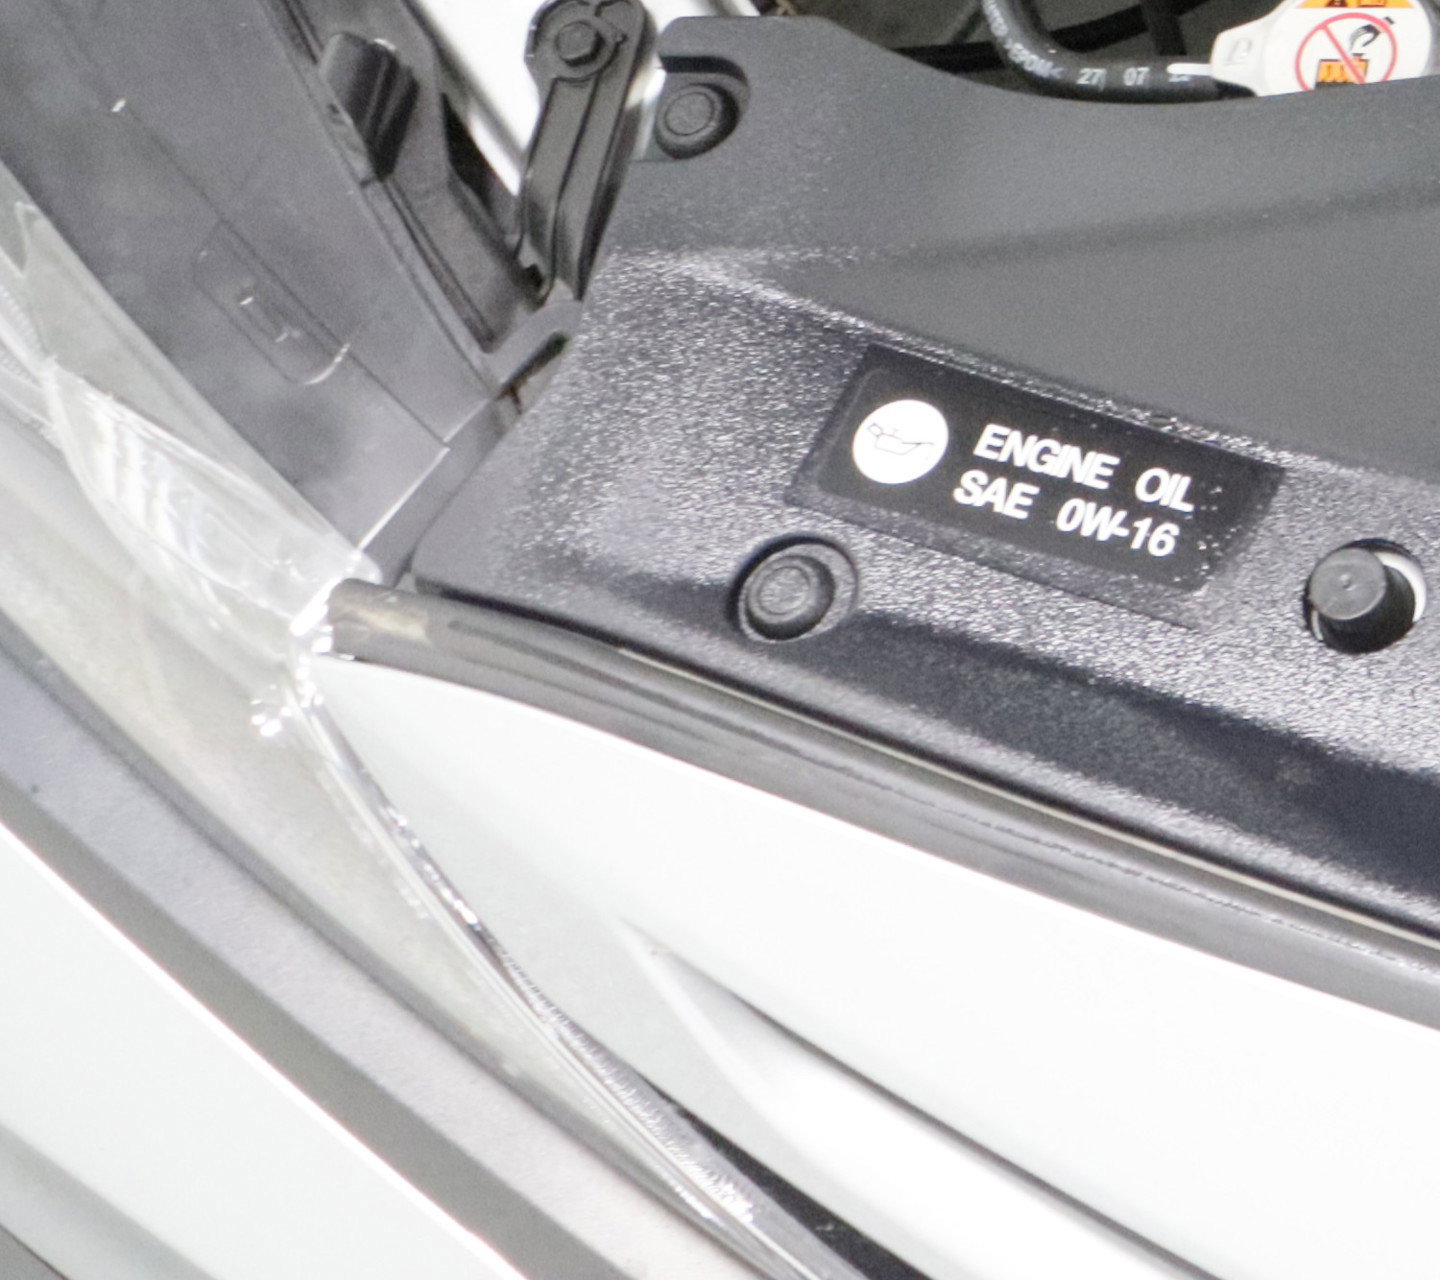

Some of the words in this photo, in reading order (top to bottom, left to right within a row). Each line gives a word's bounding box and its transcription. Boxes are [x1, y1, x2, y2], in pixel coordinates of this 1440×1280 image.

[973, 423, 1120, 490] ENGINE
[1135, 467, 1195, 513] OIL
[953, 469, 1040, 521] SAE
[1056, 498, 1181, 558] 0W-16
